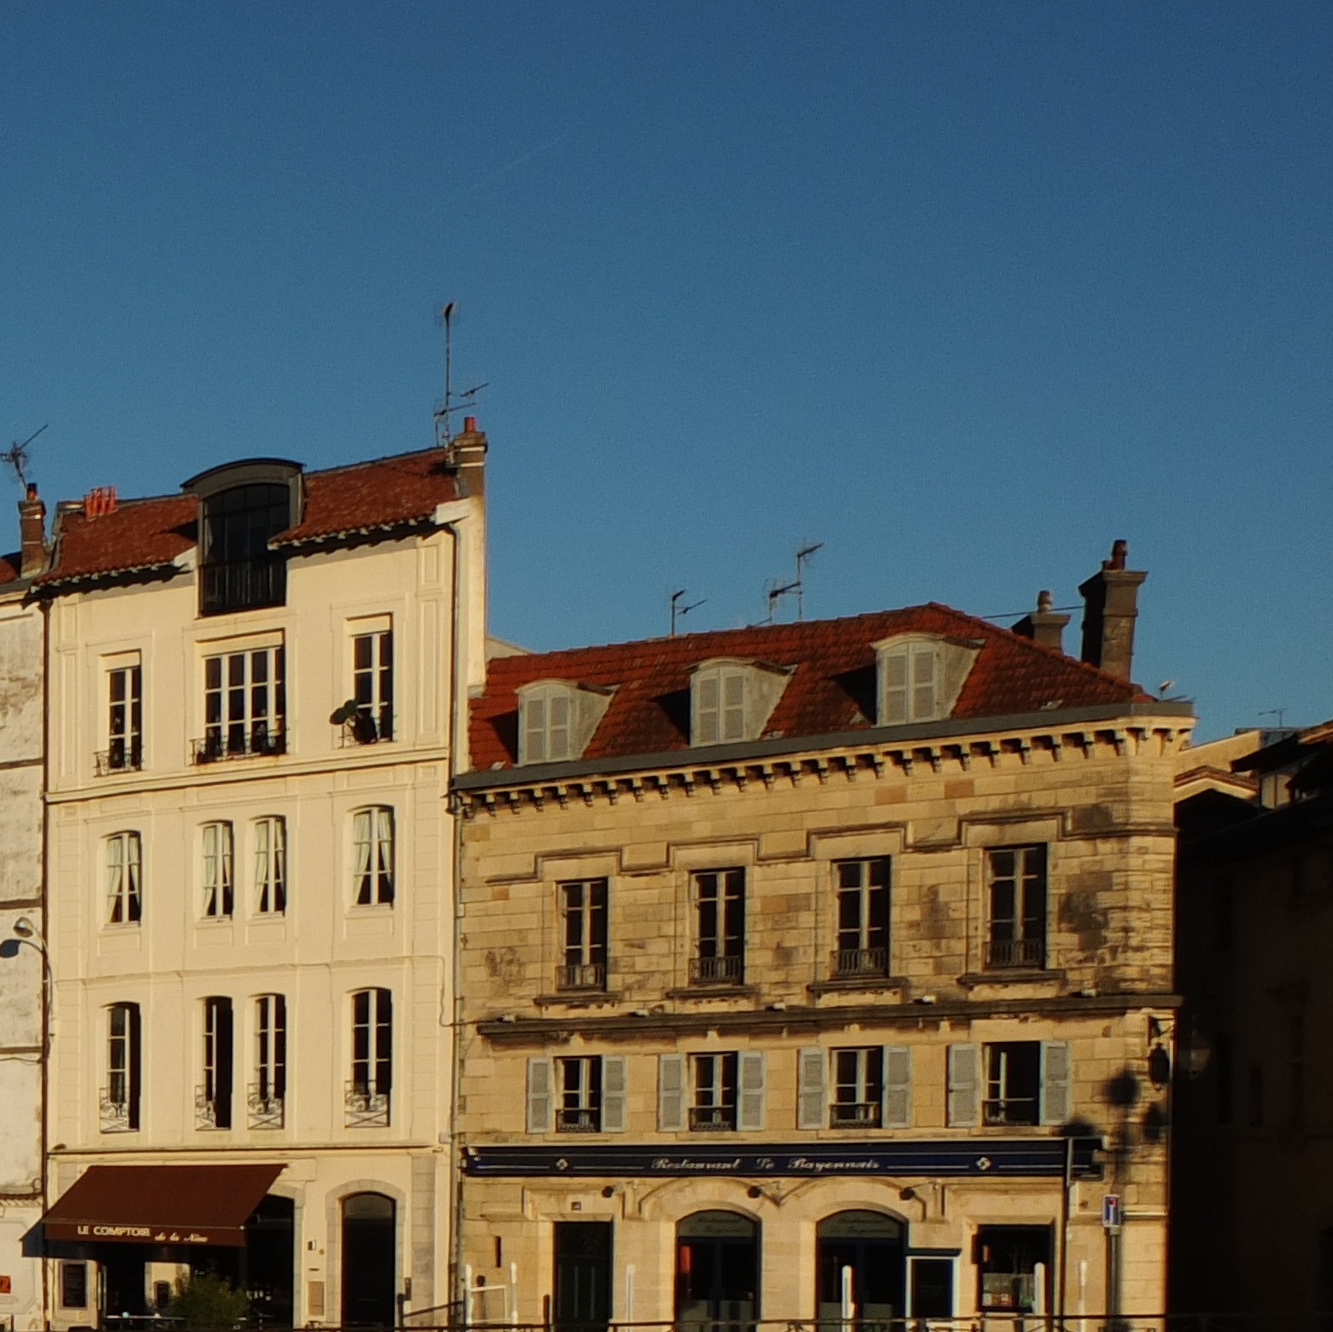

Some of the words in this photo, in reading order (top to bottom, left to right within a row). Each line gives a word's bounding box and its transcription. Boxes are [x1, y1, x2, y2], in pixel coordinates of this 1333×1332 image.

[651, 1157, 742, 1169] Restaurant
[77, 1226, 89, 1235] LE
[93, 1226, 151, 1237] COMPTOIR
